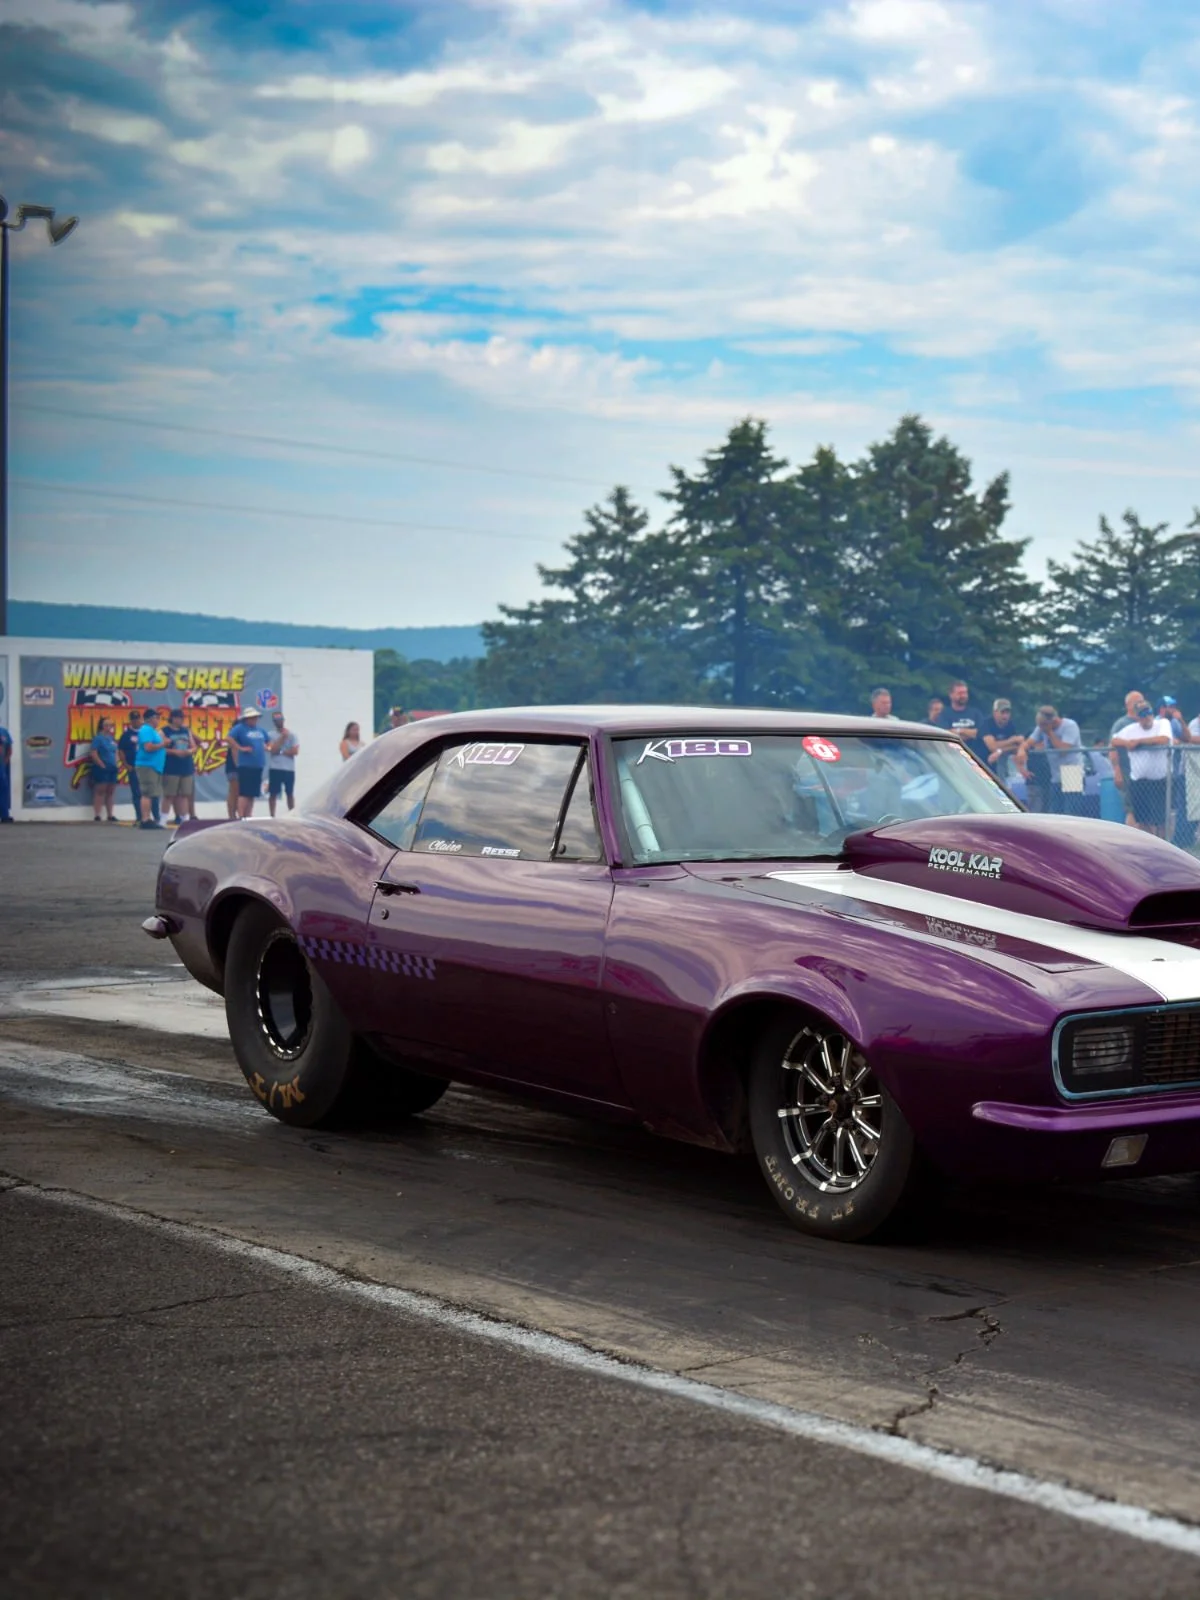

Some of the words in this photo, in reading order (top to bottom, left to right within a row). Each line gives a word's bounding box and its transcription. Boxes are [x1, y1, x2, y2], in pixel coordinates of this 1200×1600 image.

[63, 663, 170, 689] WINNER'S
[174, 666, 247, 691] CIRCLE
[447, 742, 525, 768] K180
[636, 739, 752, 765] K180
[428, 840, 463, 853] Claire
[927, 862, 1002, 879] PERFORMANCE
[928, 847, 966, 868] KOOL
[968, 853, 1003, 873] KAR
